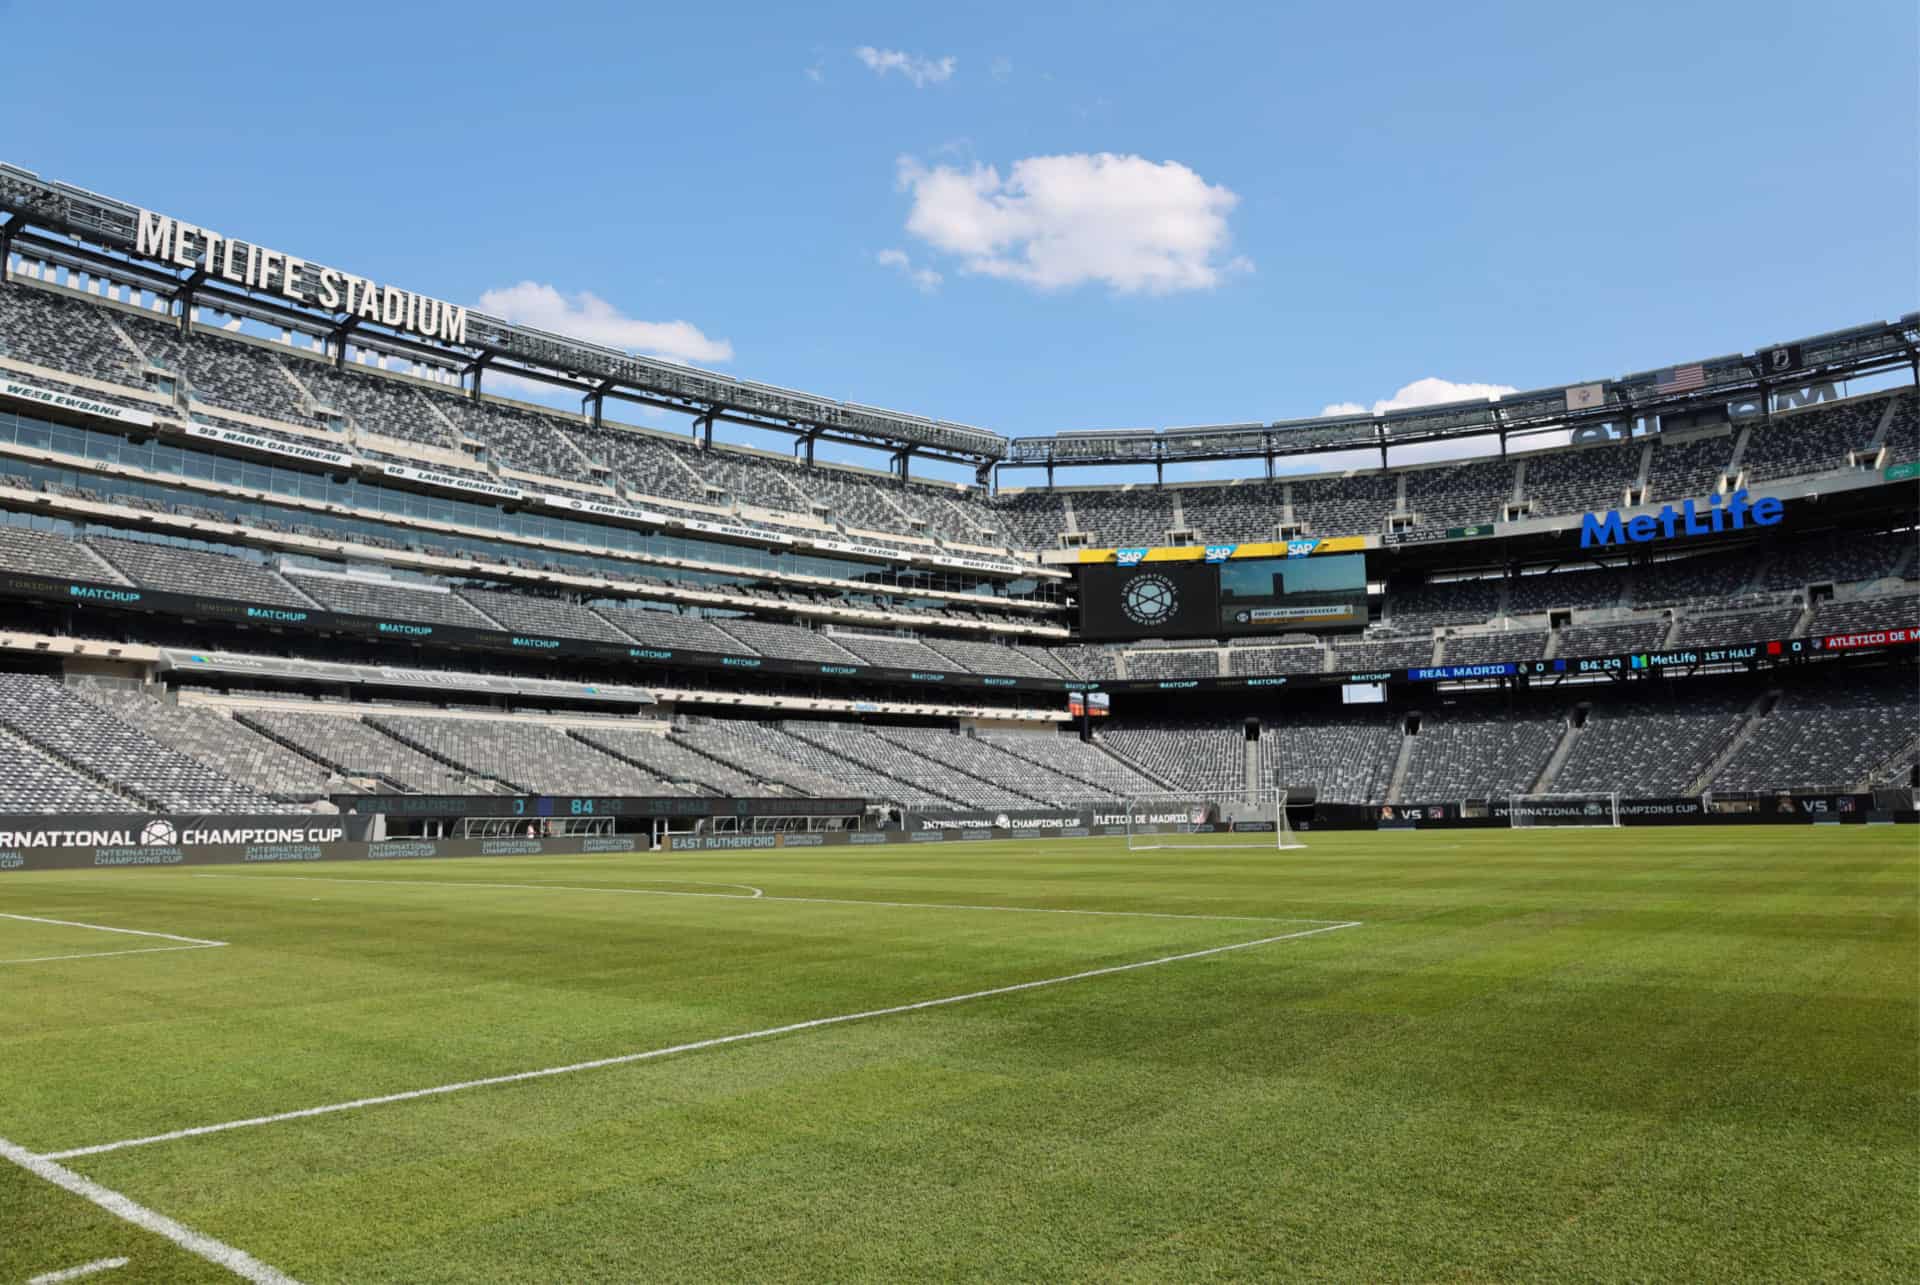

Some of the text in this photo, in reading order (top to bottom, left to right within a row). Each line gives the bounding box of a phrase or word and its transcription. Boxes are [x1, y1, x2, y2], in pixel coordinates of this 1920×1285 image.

[137, 209, 466, 343] METLIFE STADIUM
[56, 396, 121, 416] EWBANK
[198, 427, 341, 462] 99 MARK GASTINEAU
[1580, 488, 1784, 549] MetLife
[1206, 548, 1231, 560] SAP
[1288, 543, 1313, 555] SAP
[1118, 552, 1142, 562] SAP
[70, 585, 141, 602] MATCHUP
[247, 607, 307, 622] MATCHUP
[1792, 642, 1801, 651] 0
[1828, 633, 1886, 649] ATLETICO
[1889, 631, 1906, 641] DE
[1650, 652, 1697, 665] MetLife
[1704, 648, 1757, 660] 1ST HALF
[1419, 663, 1545, 678] REAL MADRID 0
[1580, 658, 1621, 671] 84:29
[571, 799, 594, 814] 84
[1494, 807, 1582, 817] INTERNATIONAL
[1675, 804, 1698, 814] CUP
[1802, 800, 1828, 812] VS
[1135, 814, 1147, 824] DE
[1150, 813, 1188, 824] MADRID
[1401, 808, 1422, 820] VS
[1012, 819, 1063, 828] CHAMPIONS
[1064, 818, 1080, 827] CUP
[182, 829, 304, 845] CHAMPIONS
[308, 828, 343, 842] CUP
[672, 838, 701, 849] EAST
[705, 836, 775, 848] RUTHERFORD
[95, 855, 183, 864] CHAMPIONS CUP
[96, 849, 182, 857] INTERNATIONAL
